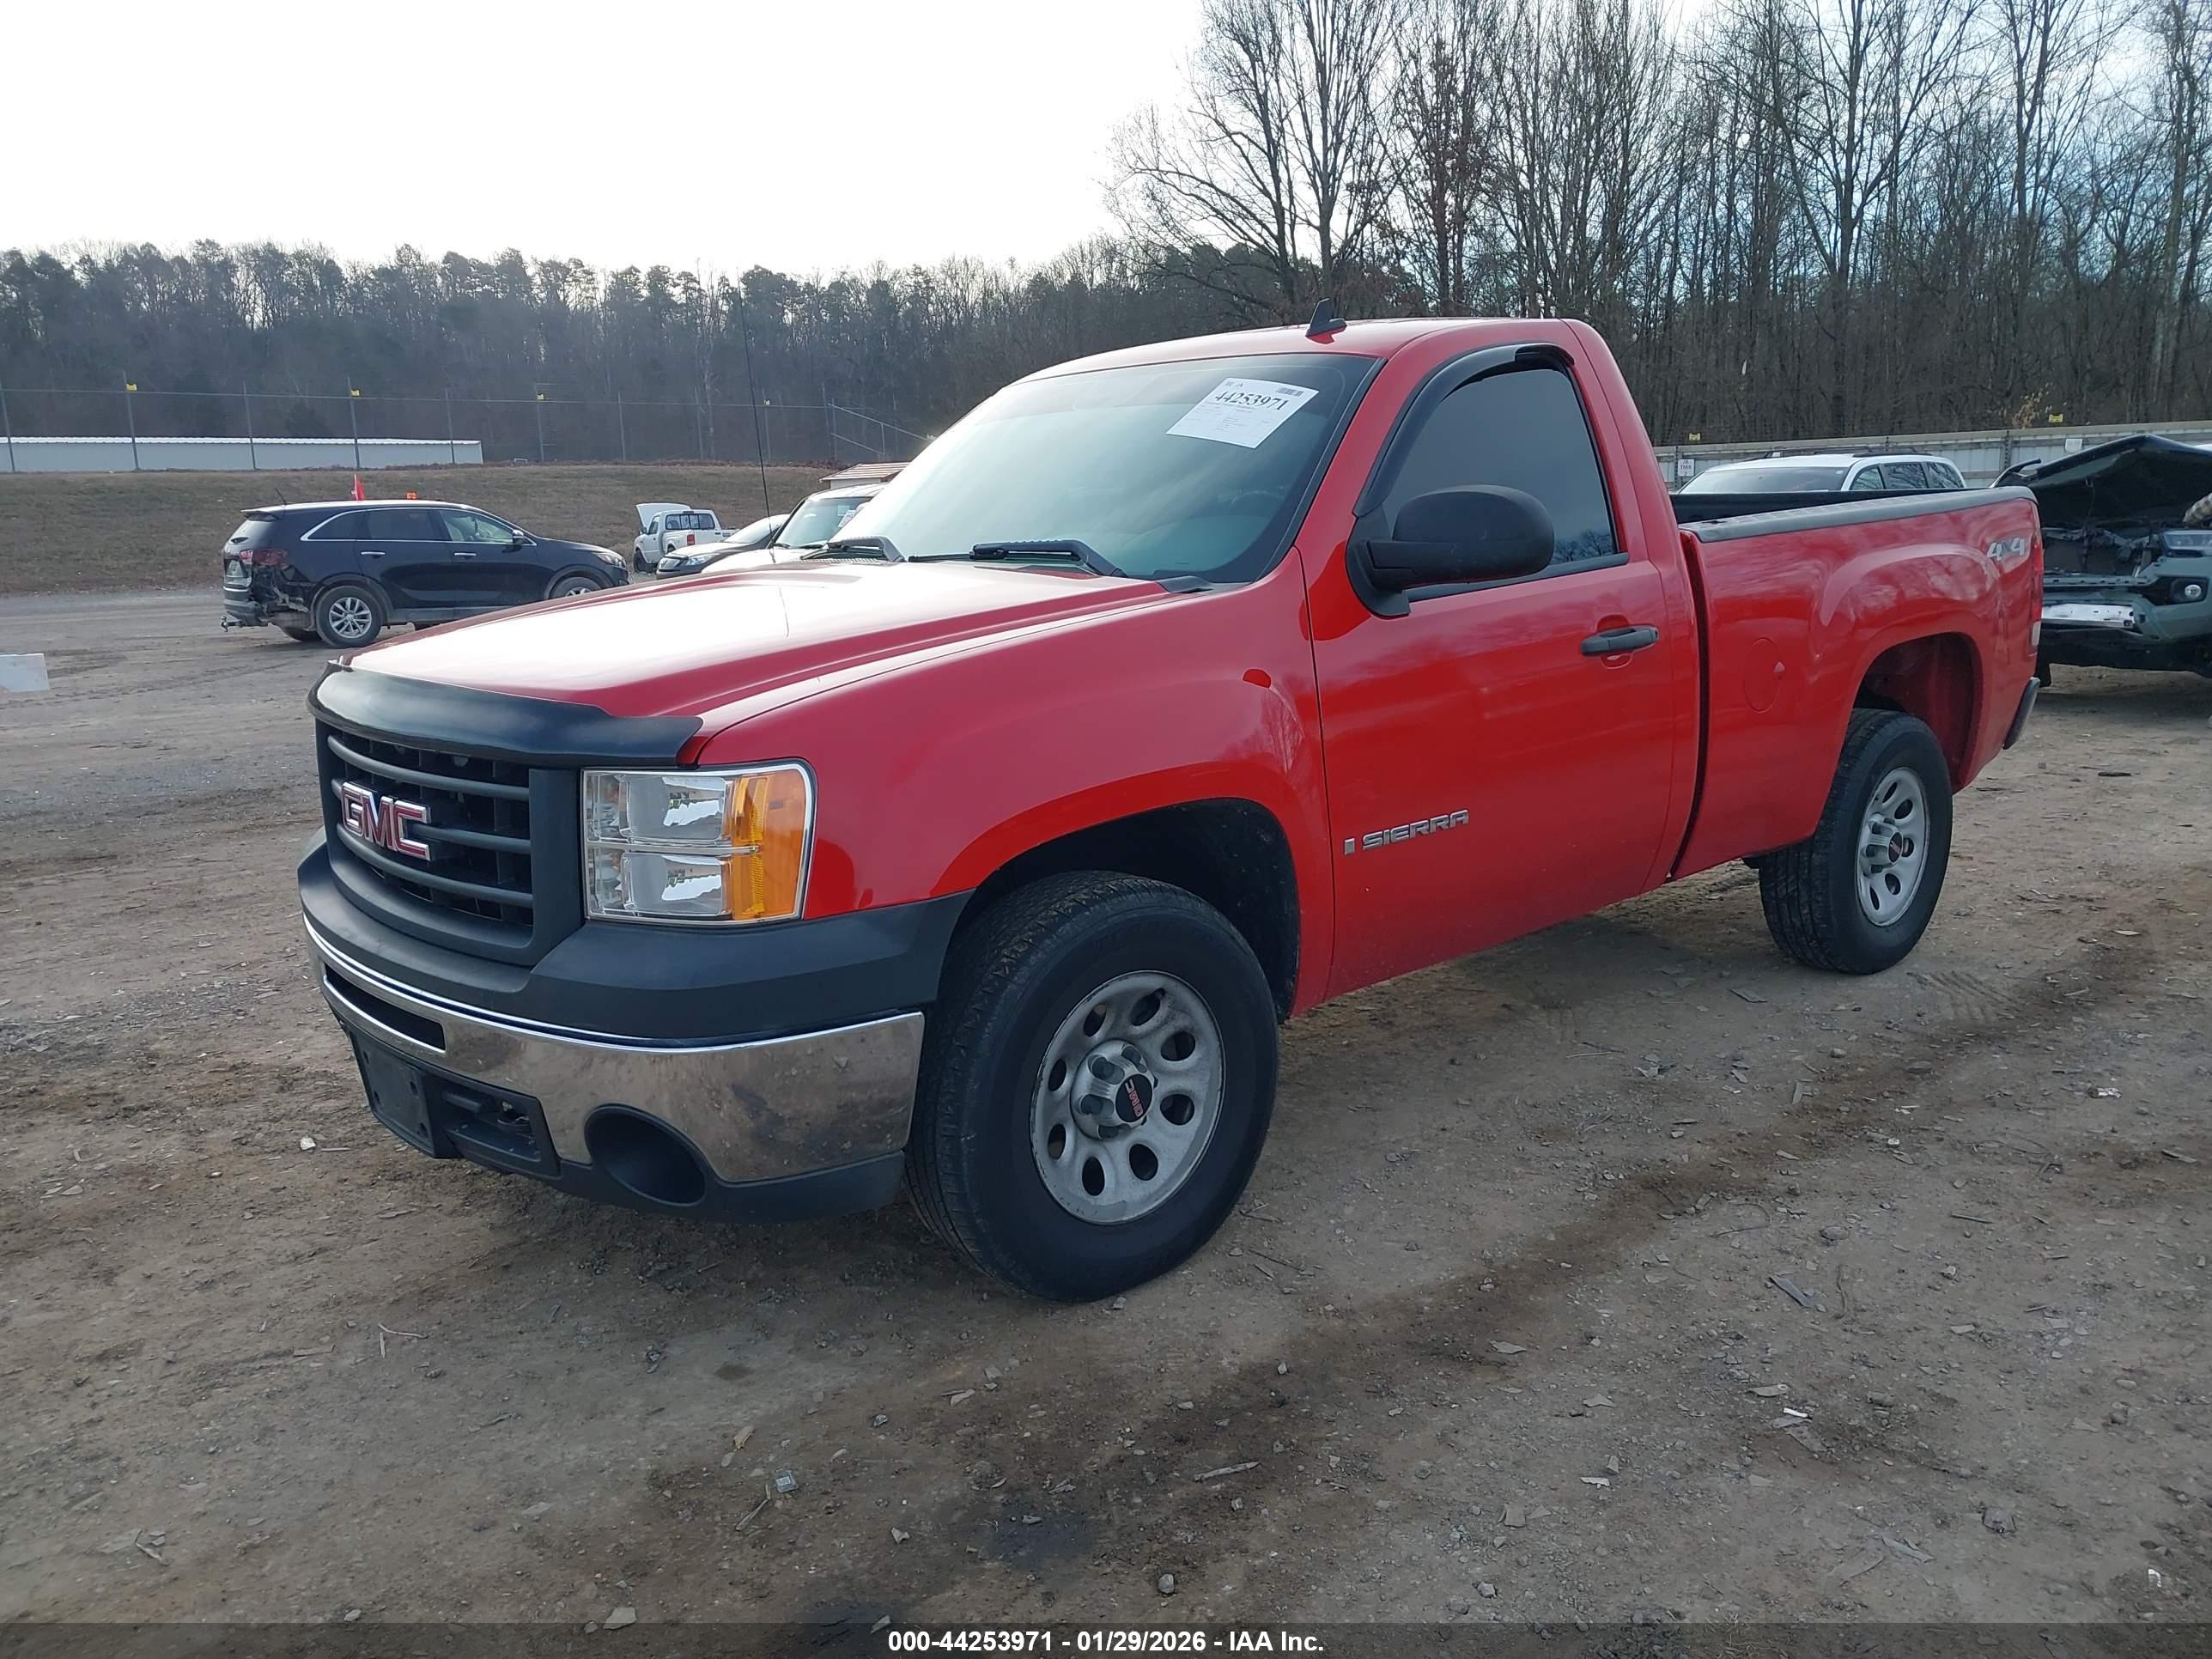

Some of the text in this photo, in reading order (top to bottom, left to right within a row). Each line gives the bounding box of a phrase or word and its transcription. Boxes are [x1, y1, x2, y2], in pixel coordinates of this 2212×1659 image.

[1214, 391, 1290, 410] 44253971
[342, 781, 431, 861] GMC
[1362, 809, 1469, 851] SIERRA
[1125, 1078, 1144, 1117] GMC
